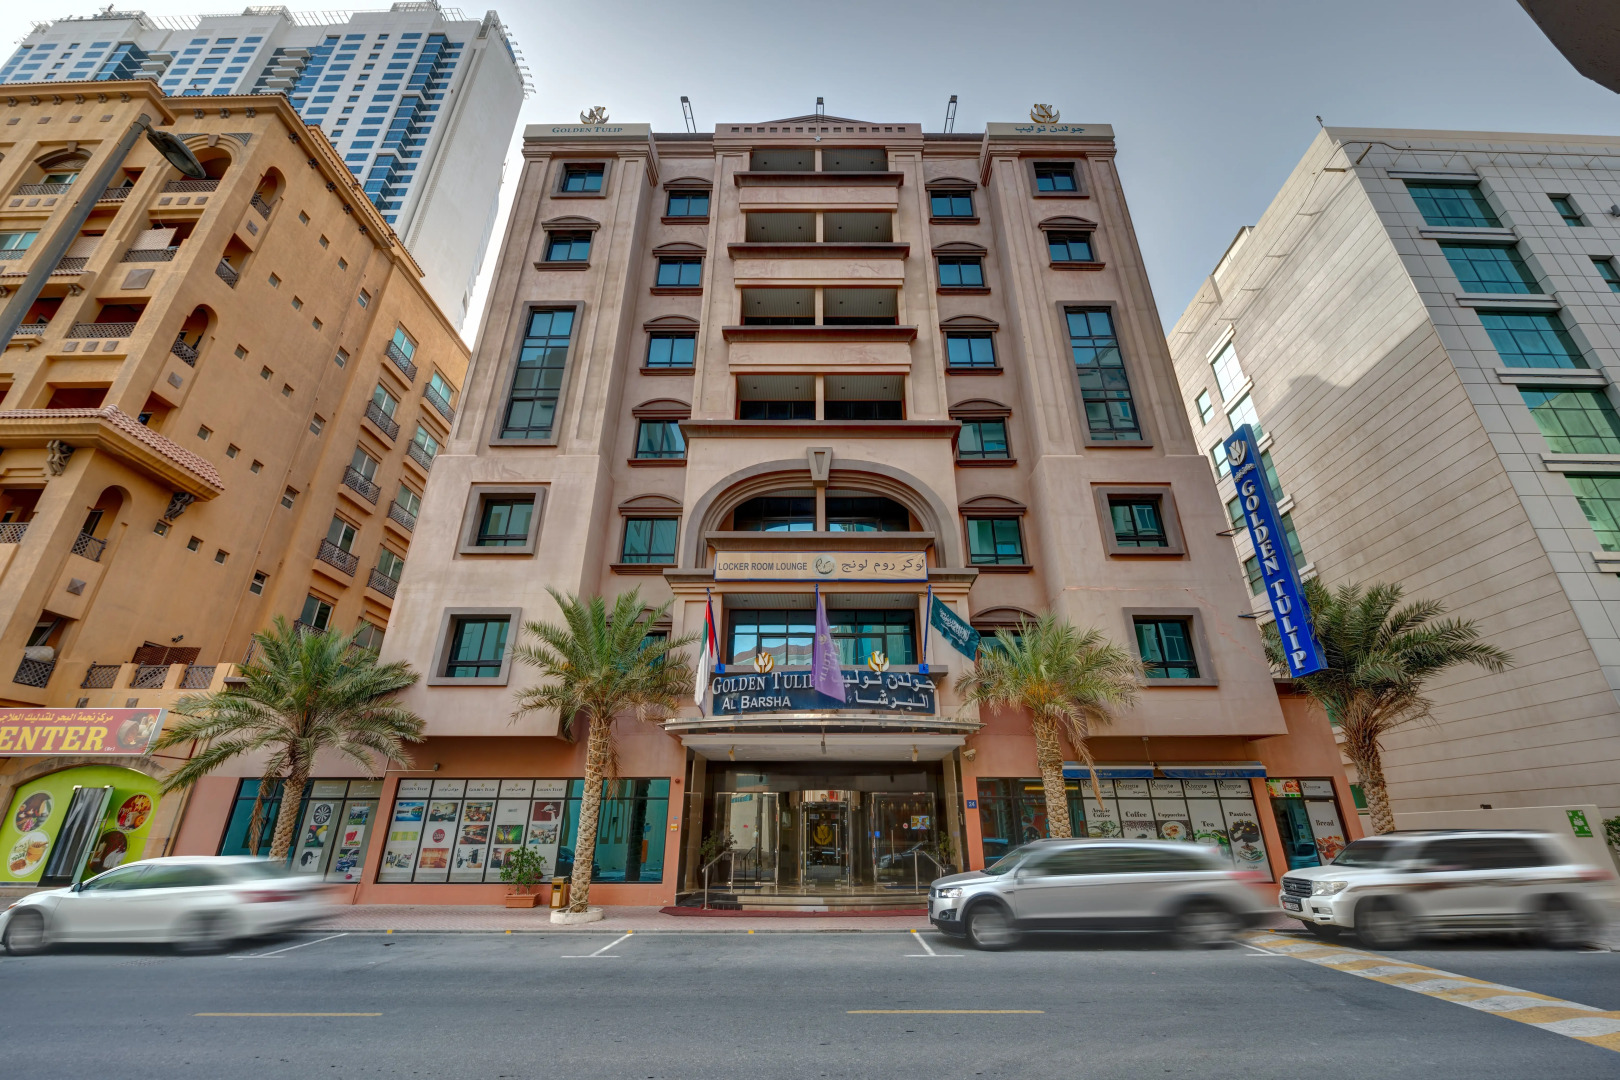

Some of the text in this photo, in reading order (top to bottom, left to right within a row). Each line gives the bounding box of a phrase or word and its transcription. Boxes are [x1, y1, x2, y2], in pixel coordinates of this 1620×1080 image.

[718, 562, 807, 571] LOCKER ROOM LOUNGE
[841, 558, 924, 573] لوكر روم لونج
[1241, 479, 1280, 576] GOLDEN
[1270, 578, 1308, 671] TULIP
[712, 676, 766, 695] GOLDEN
[886, 672, 936, 693] جولدن
[722, 696, 791, 710] AL BARSHA
